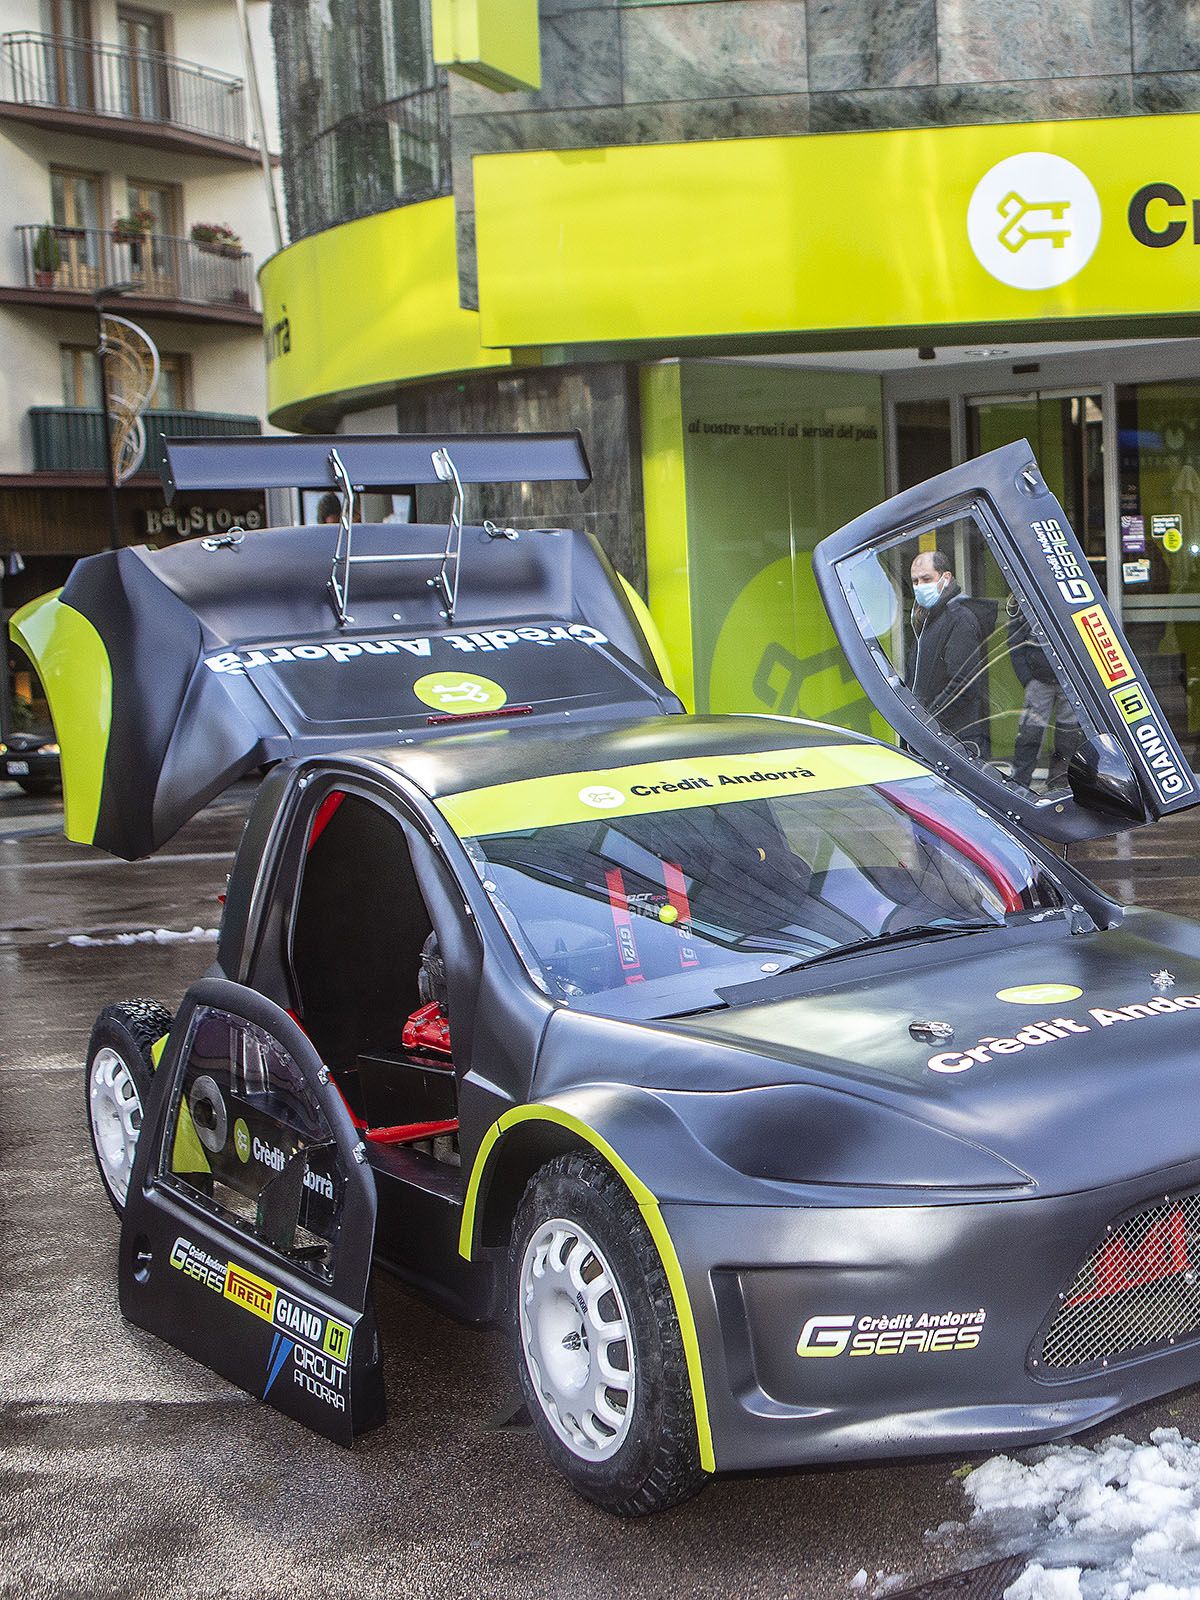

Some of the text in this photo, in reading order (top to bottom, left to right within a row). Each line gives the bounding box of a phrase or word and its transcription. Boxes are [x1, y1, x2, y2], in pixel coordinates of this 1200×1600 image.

[203, 624, 609, 676] Crèdit Andorrà
[1080, 611, 1128, 682] PIRELLI
[1136, 724, 1184, 794] GIAND
[630, 767, 816, 797] Crèdit Andorrà
[927, 1017, 1091, 1075] Crèdit
[253, 1136, 286, 1172] Crèdit
[227, 1271, 272, 1314] PIRELLI
[276, 1298, 322, 1342] GIAND
[850, 1325, 983, 1357] SERIES
[857, 1307, 987, 1331] Crèdit Andorrà
[294, 1344, 347, 1390] CIRCUIT
[294, 1368, 345, 1412] ANDORRA
